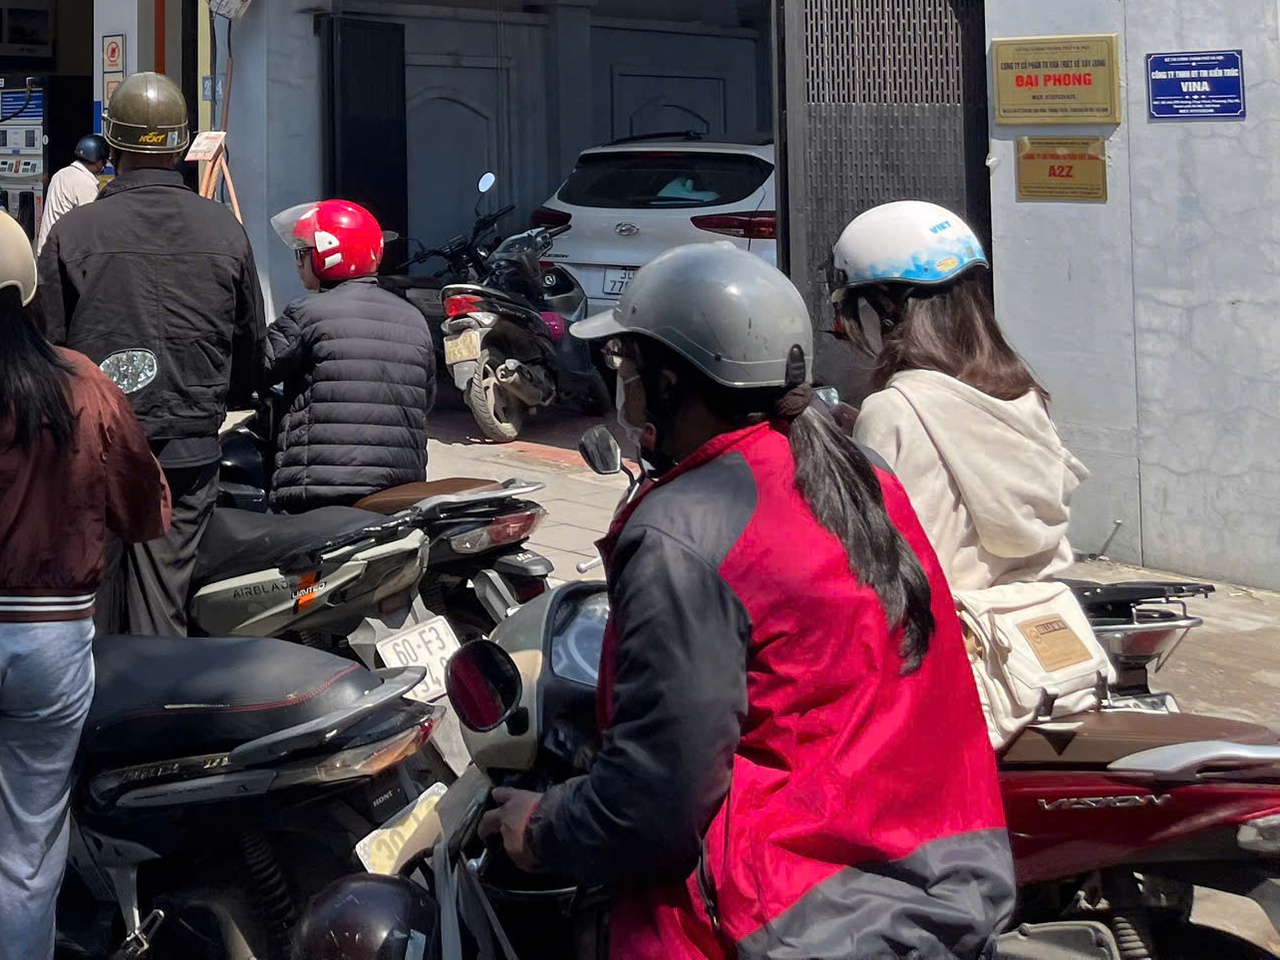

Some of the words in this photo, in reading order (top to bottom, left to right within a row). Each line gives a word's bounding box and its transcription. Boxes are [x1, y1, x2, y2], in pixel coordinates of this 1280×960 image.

[1043, 72, 1092, 87] PHONG
[1180, 81, 1210, 92] VINA
[1048, 165, 1073, 178] A2Z
